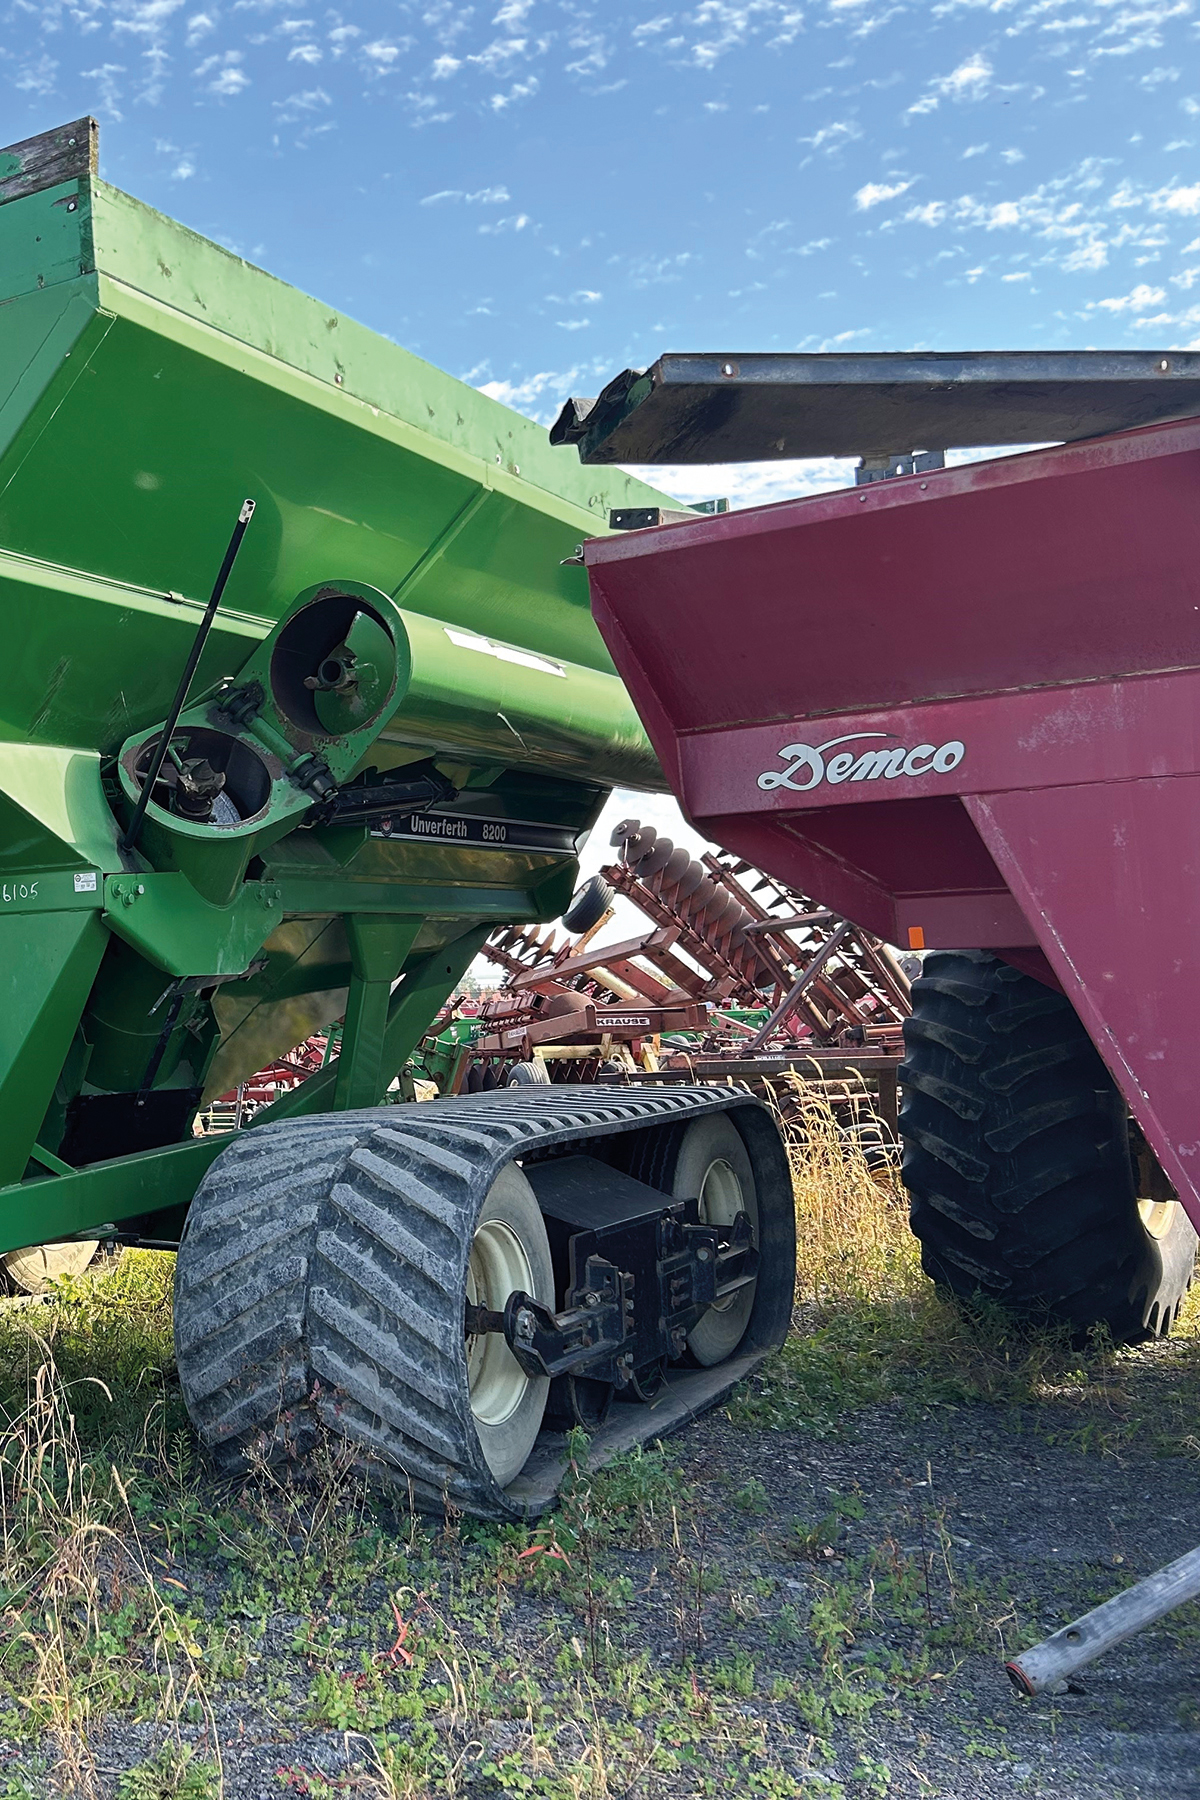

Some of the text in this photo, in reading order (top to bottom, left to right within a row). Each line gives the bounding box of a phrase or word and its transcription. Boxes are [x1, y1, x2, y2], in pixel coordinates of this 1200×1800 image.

[756, 731, 966, 792] Demco
[410, 815, 507, 842] Unverferth 8200
[596, 1018, 649, 1026] KRAUSE
